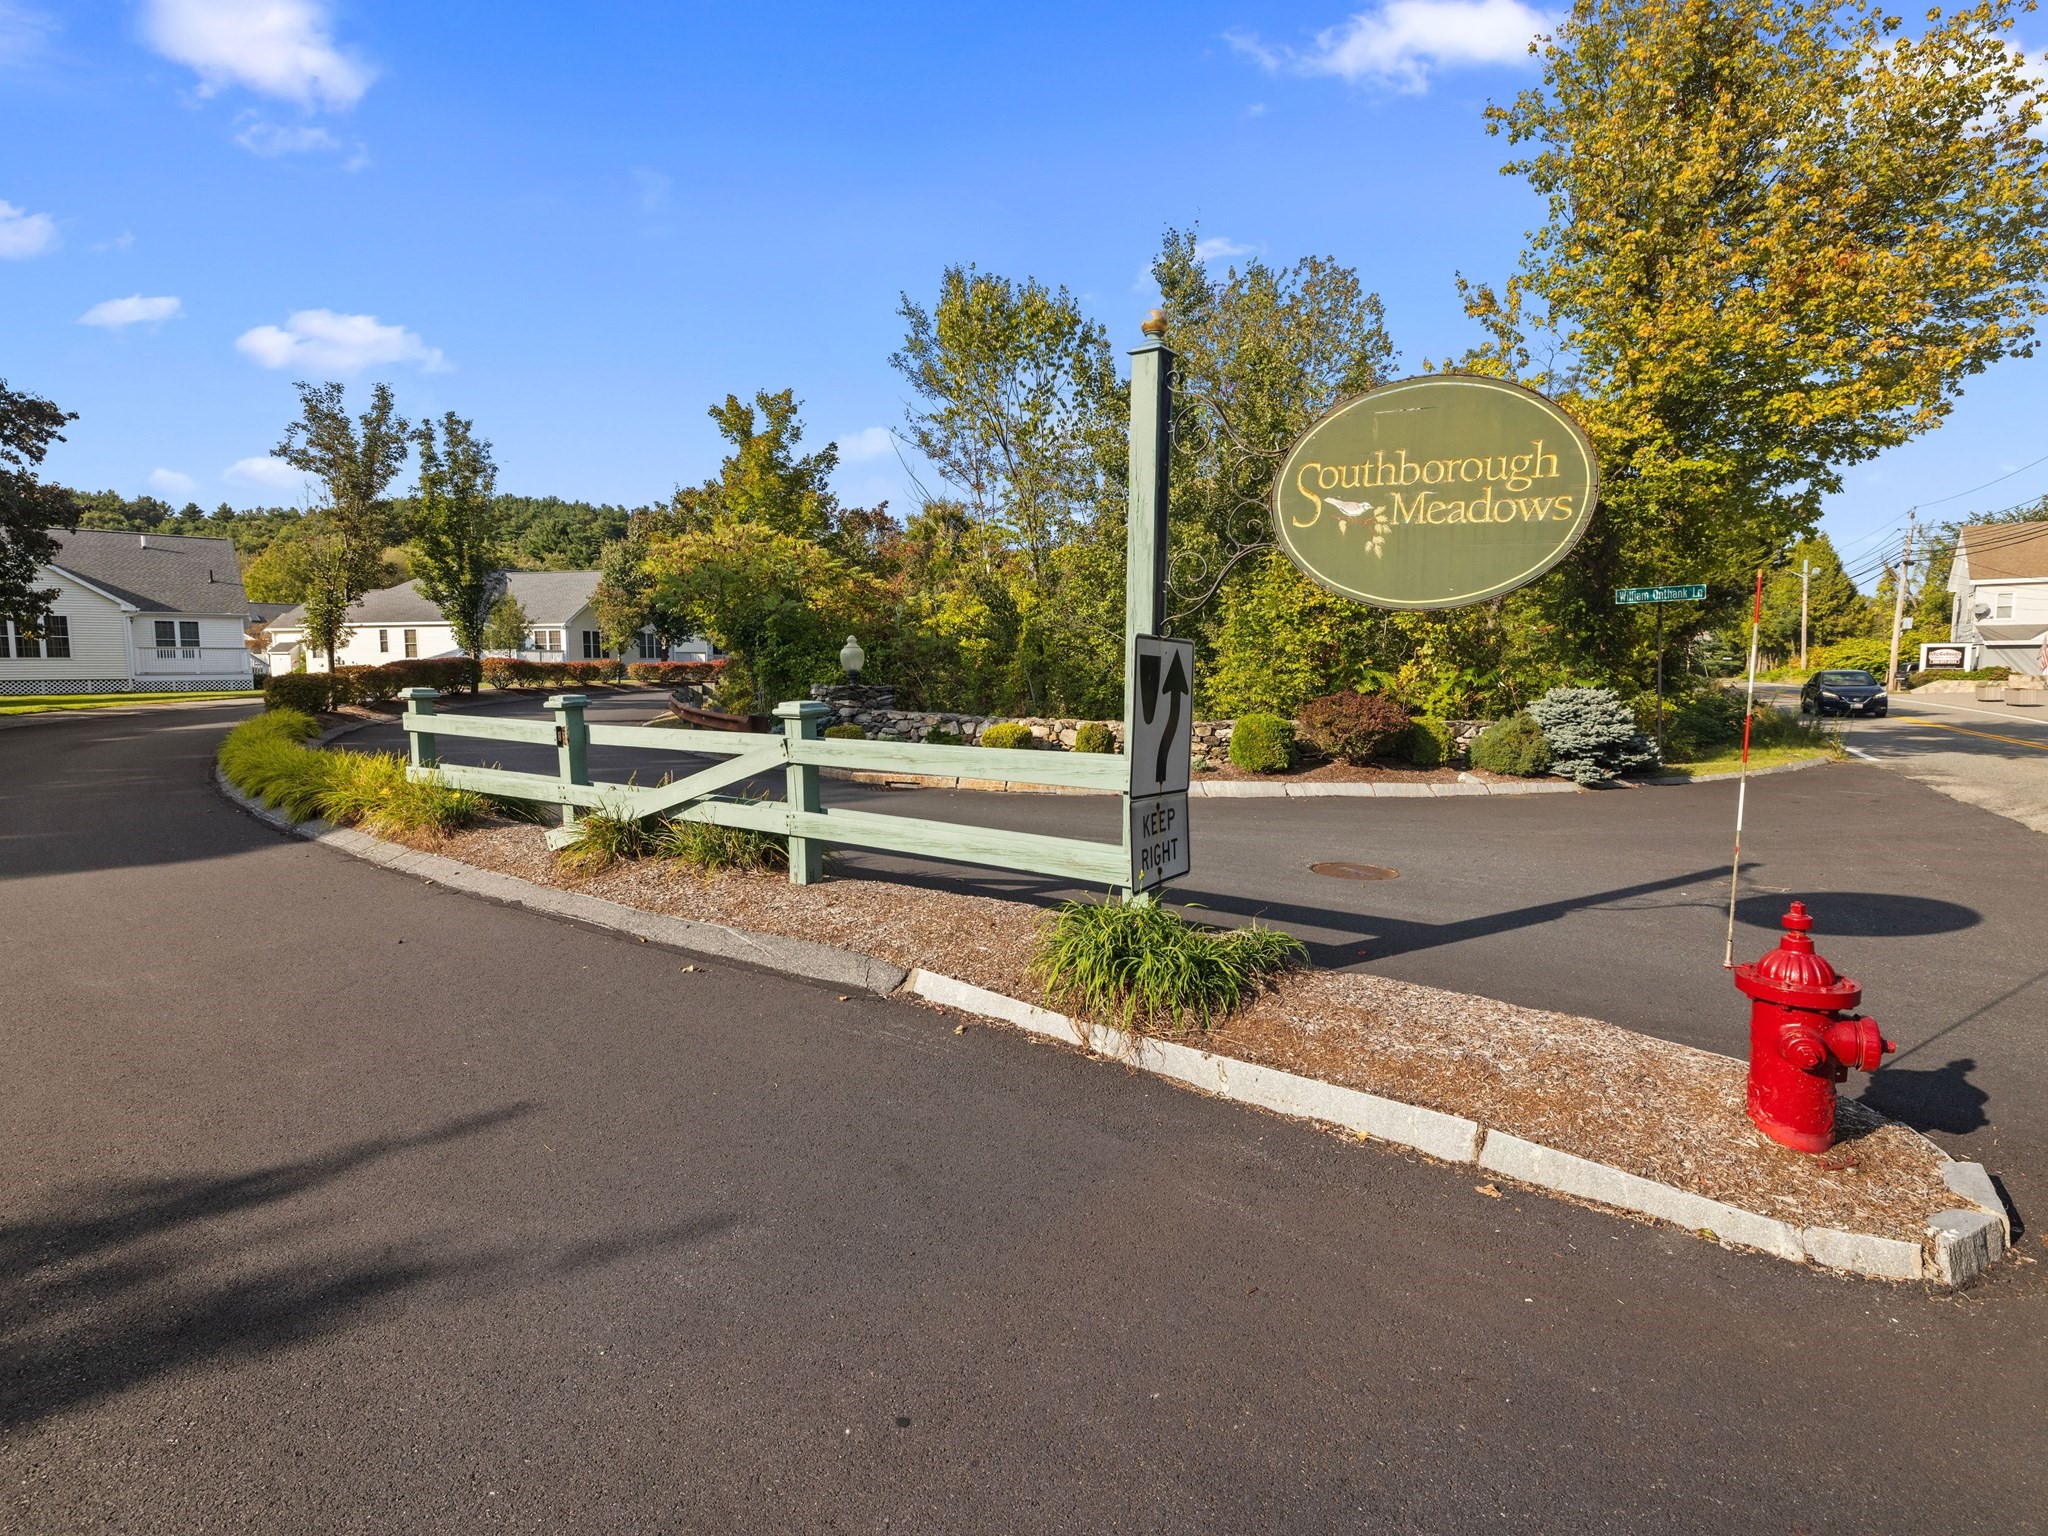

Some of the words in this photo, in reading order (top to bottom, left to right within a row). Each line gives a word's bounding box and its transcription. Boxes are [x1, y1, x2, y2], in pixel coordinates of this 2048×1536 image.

[1293, 440, 1559, 527] Southborough
[1390, 486, 1573, 525] Meadows
[1619, 590, 1650, 602] William
[1652, 588, 1688, 600] Onthank
[1692, 587, 1703, 598] Ln
[1143, 808, 1175, 838] KEEP
[1141, 838, 1178, 871] RIGHT
